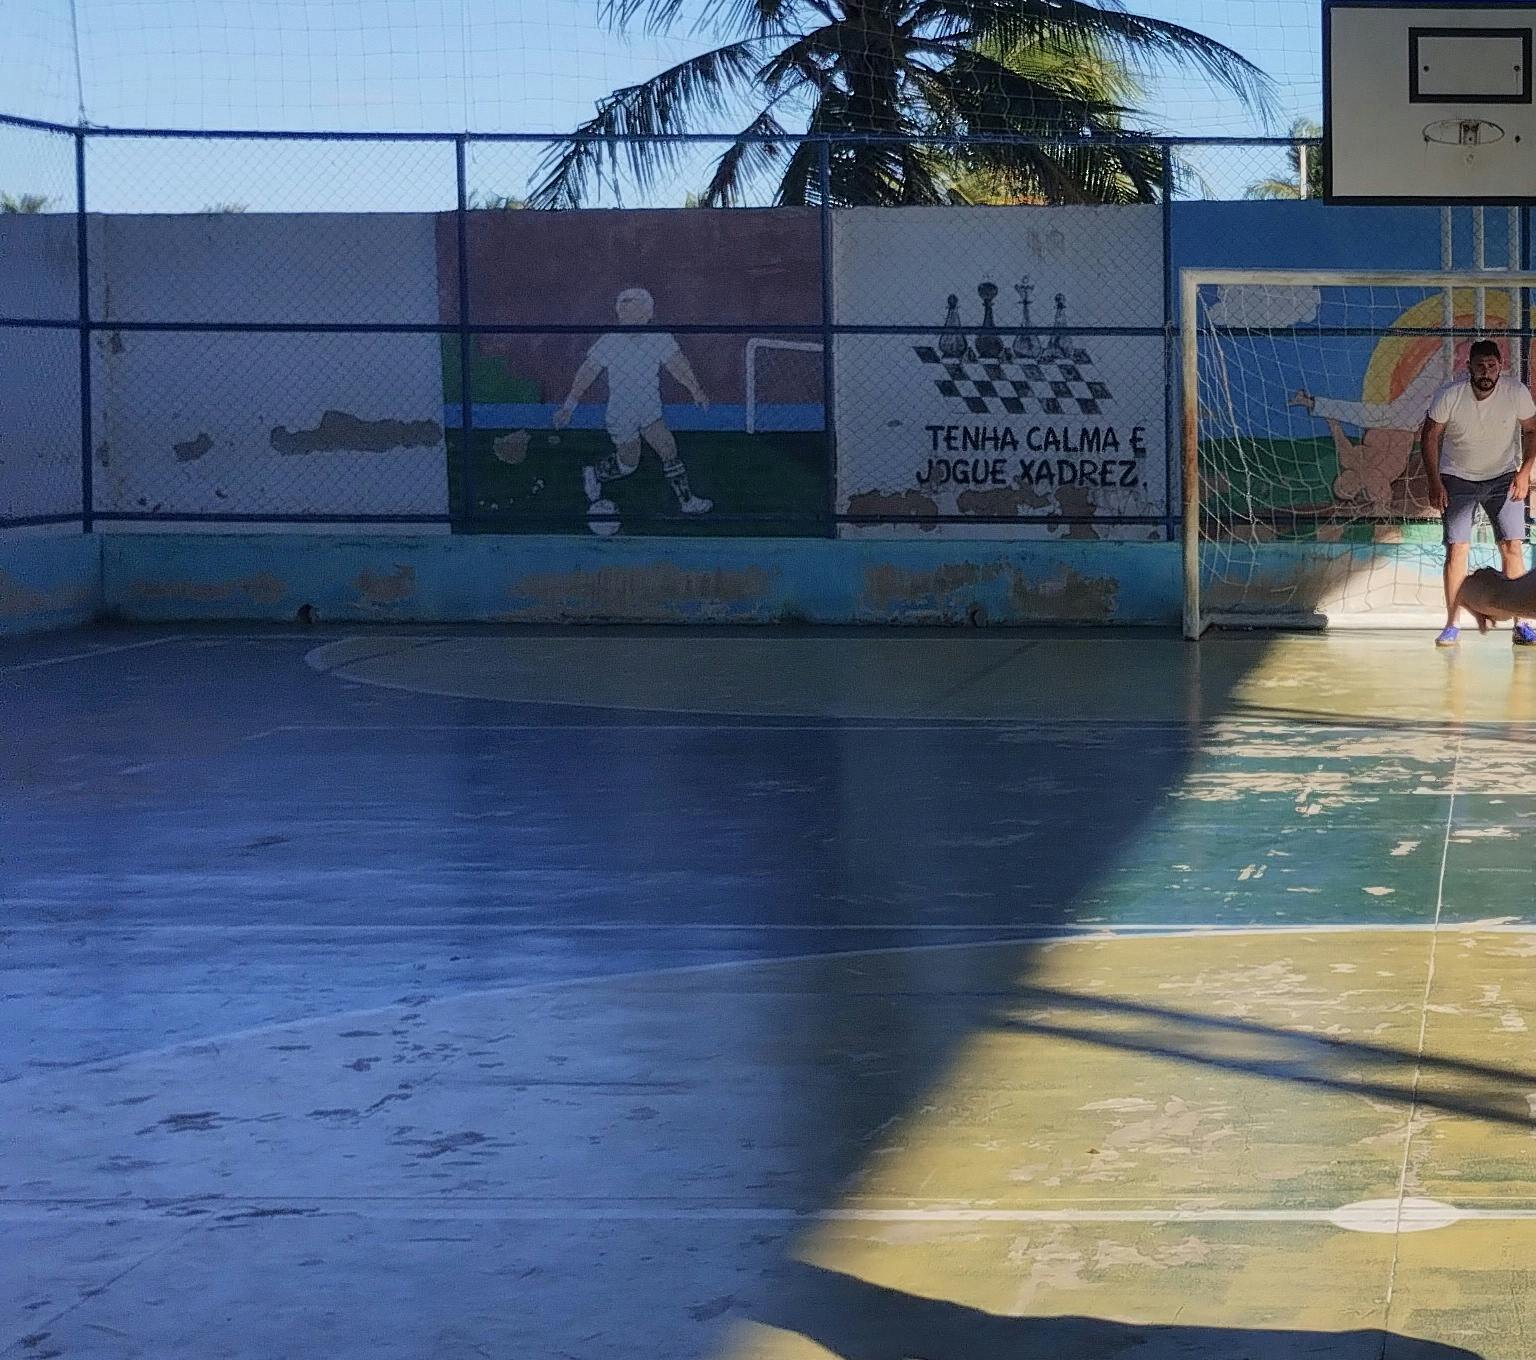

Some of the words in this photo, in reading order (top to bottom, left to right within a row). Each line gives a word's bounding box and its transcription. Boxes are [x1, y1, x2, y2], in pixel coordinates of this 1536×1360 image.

[924, 425, 1019, 452] TENHA
[1026, 425, 1120, 453] CALMA
[1129, 426, 1146, 452] E
[916, 459, 1007, 485] JOGUE
[1019, 459, 1148, 489] XADREZ.
